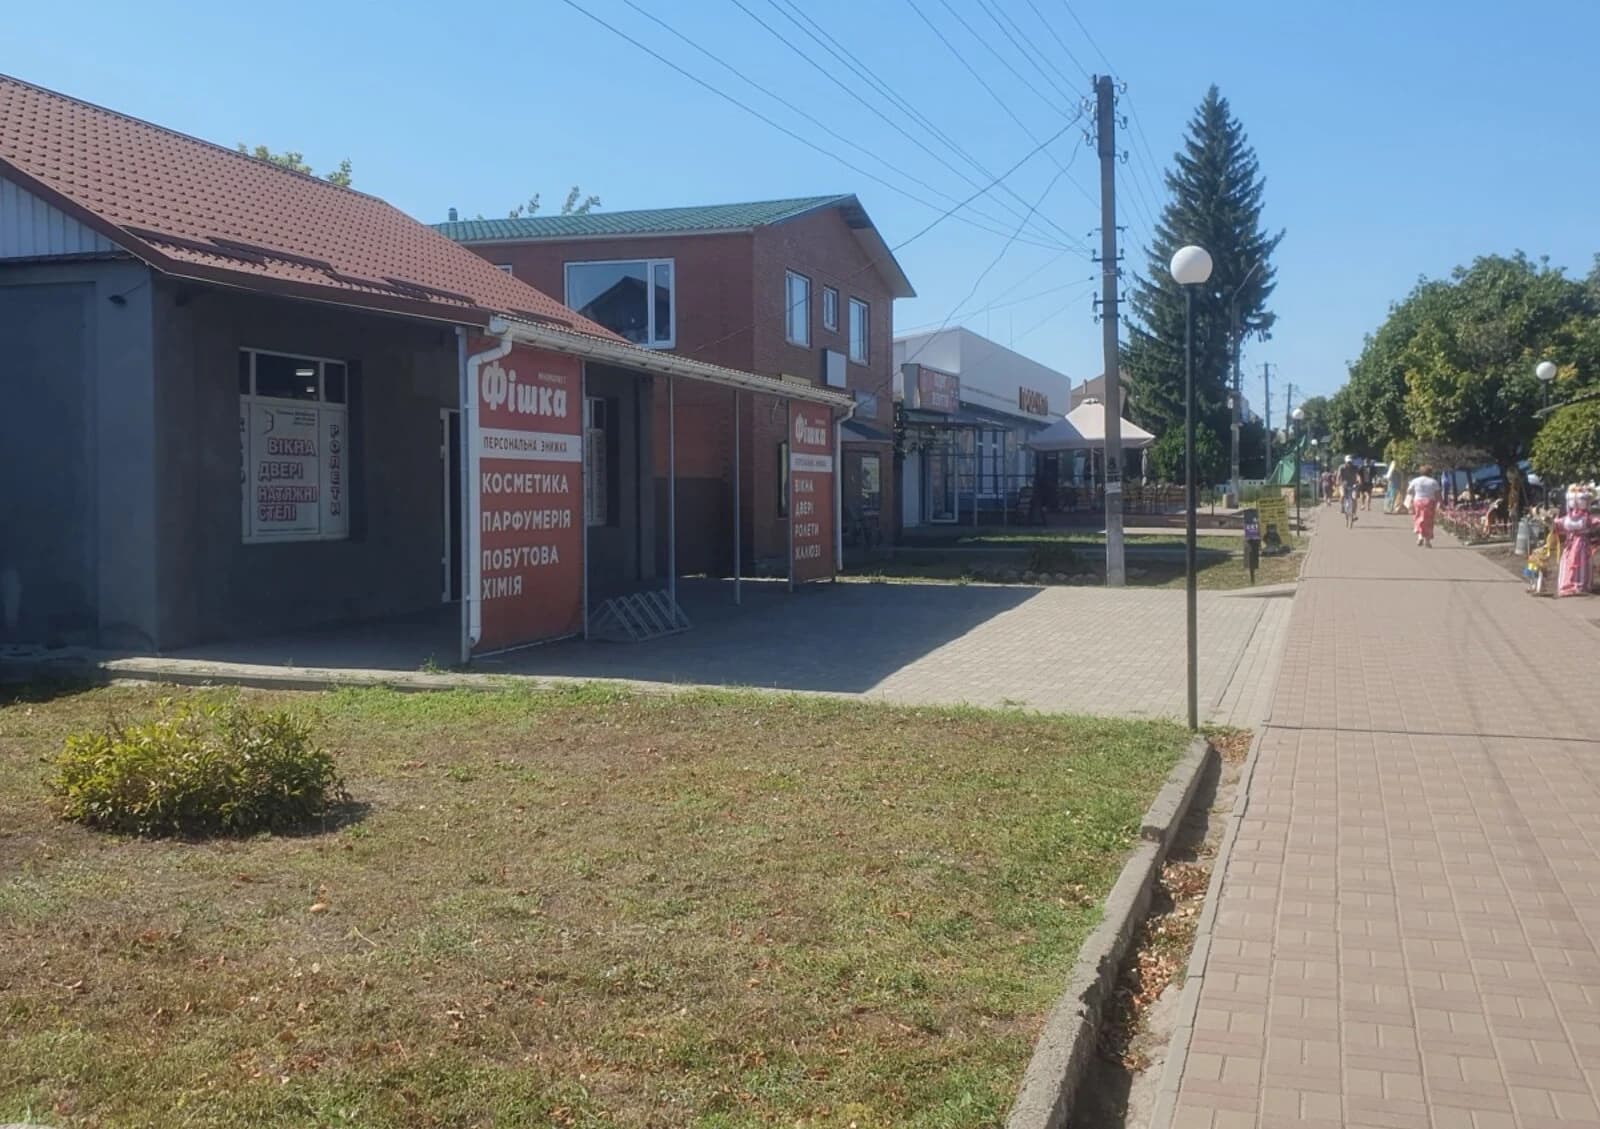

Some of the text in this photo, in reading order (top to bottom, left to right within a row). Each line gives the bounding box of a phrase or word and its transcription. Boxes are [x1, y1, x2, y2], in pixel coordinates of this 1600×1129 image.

[482, 360, 567, 418] Фішка
[267, 437, 317, 456] ВІКНА
[483, 436, 567, 453] ПЕРСОНАЛЬНА ЗНИЖКА
[258, 461, 303, 482] ДВЕРІ
[329, 424, 341, 516] РОЛЕТИ
[482, 472, 569, 494] КОСМЕТИКА
[257, 486, 318, 503] НАТЯЖНІ
[258, 504, 297, 521] СТЕЛІ
[482, 509, 571, 532] ПАРФУМЕРІЯ
[482, 546, 560, 571] ПОБУТОВА
[482, 576, 523, 600] ХІМІЯ
